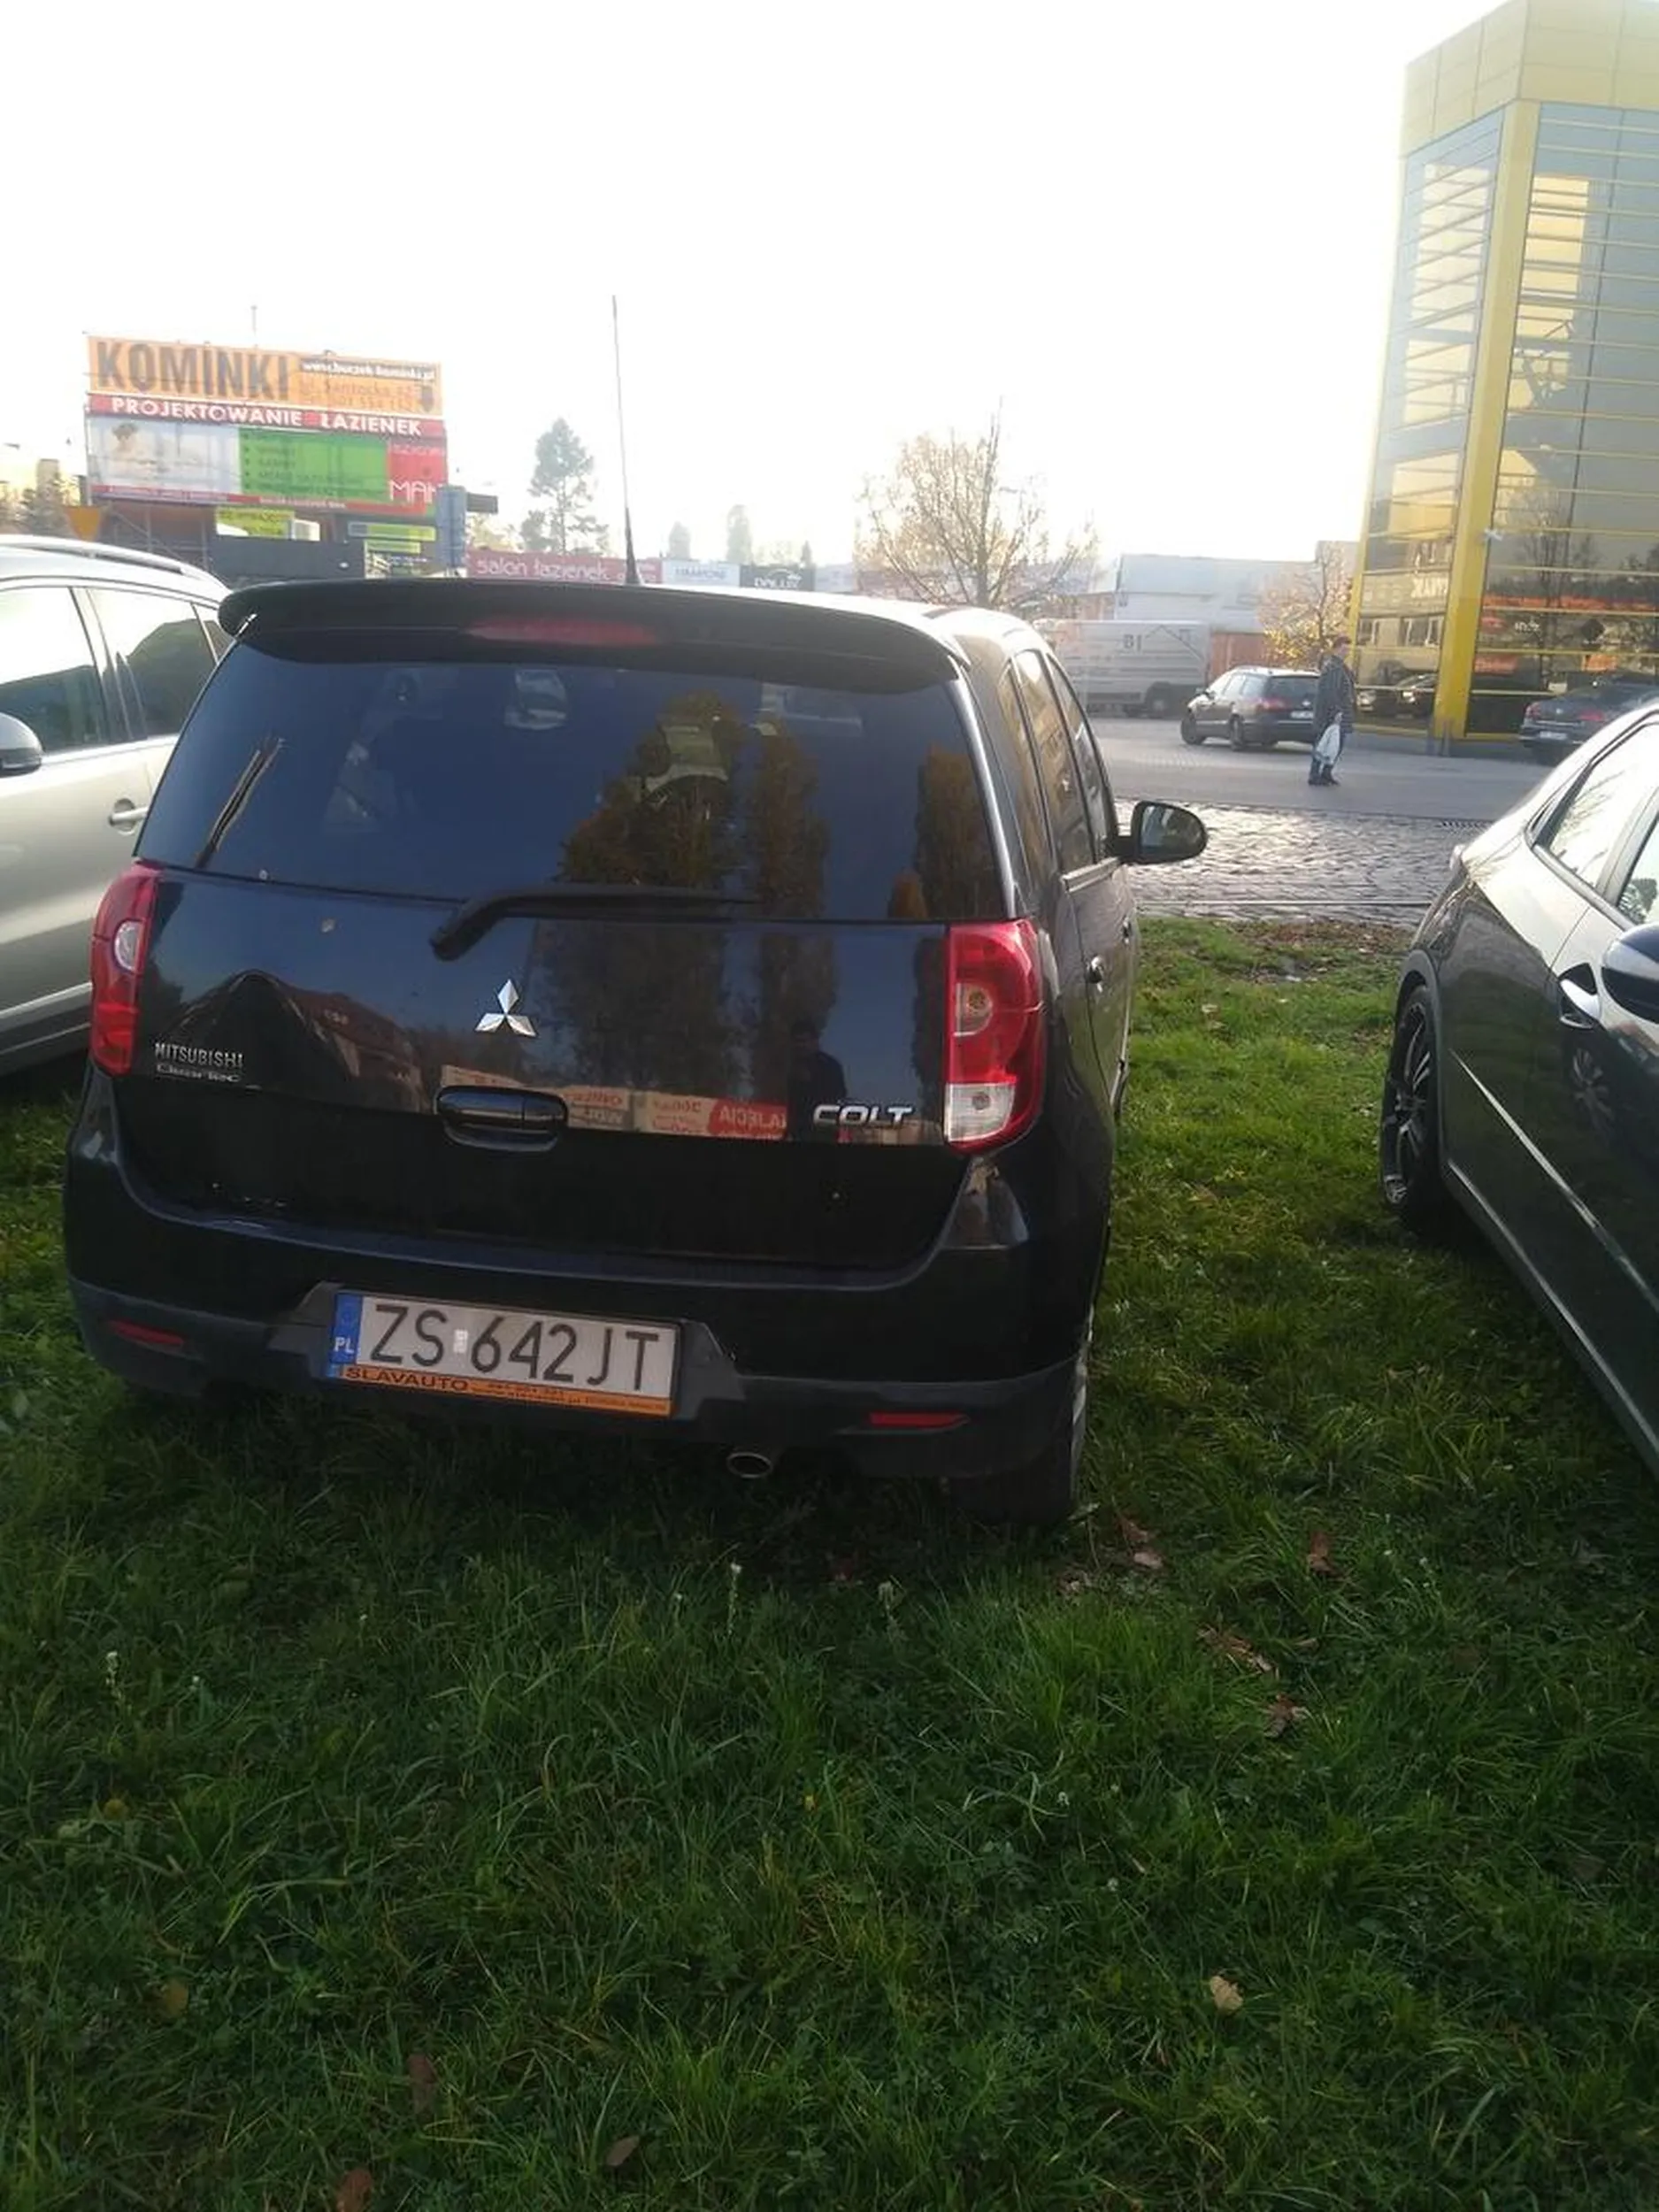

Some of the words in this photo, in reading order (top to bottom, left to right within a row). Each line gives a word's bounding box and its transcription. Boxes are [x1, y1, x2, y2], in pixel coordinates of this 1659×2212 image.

[97, 342, 289, 401] KOMINKI
[111, 397, 303, 426] PROJEKTOWANIE
[320, 410, 423, 436] ŁAZIENEK
[477, 557, 527, 576] salon
[155, 1043, 243, 1070] MITSUBISHI
[813, 1103, 913, 1126] COLT
[334, 1336, 355, 1354] PL
[370, 1303, 448, 1367] ZS
[470, 1316, 659, 1392] 642JT
[345, 1367, 469, 1392] SLAVAUTO
